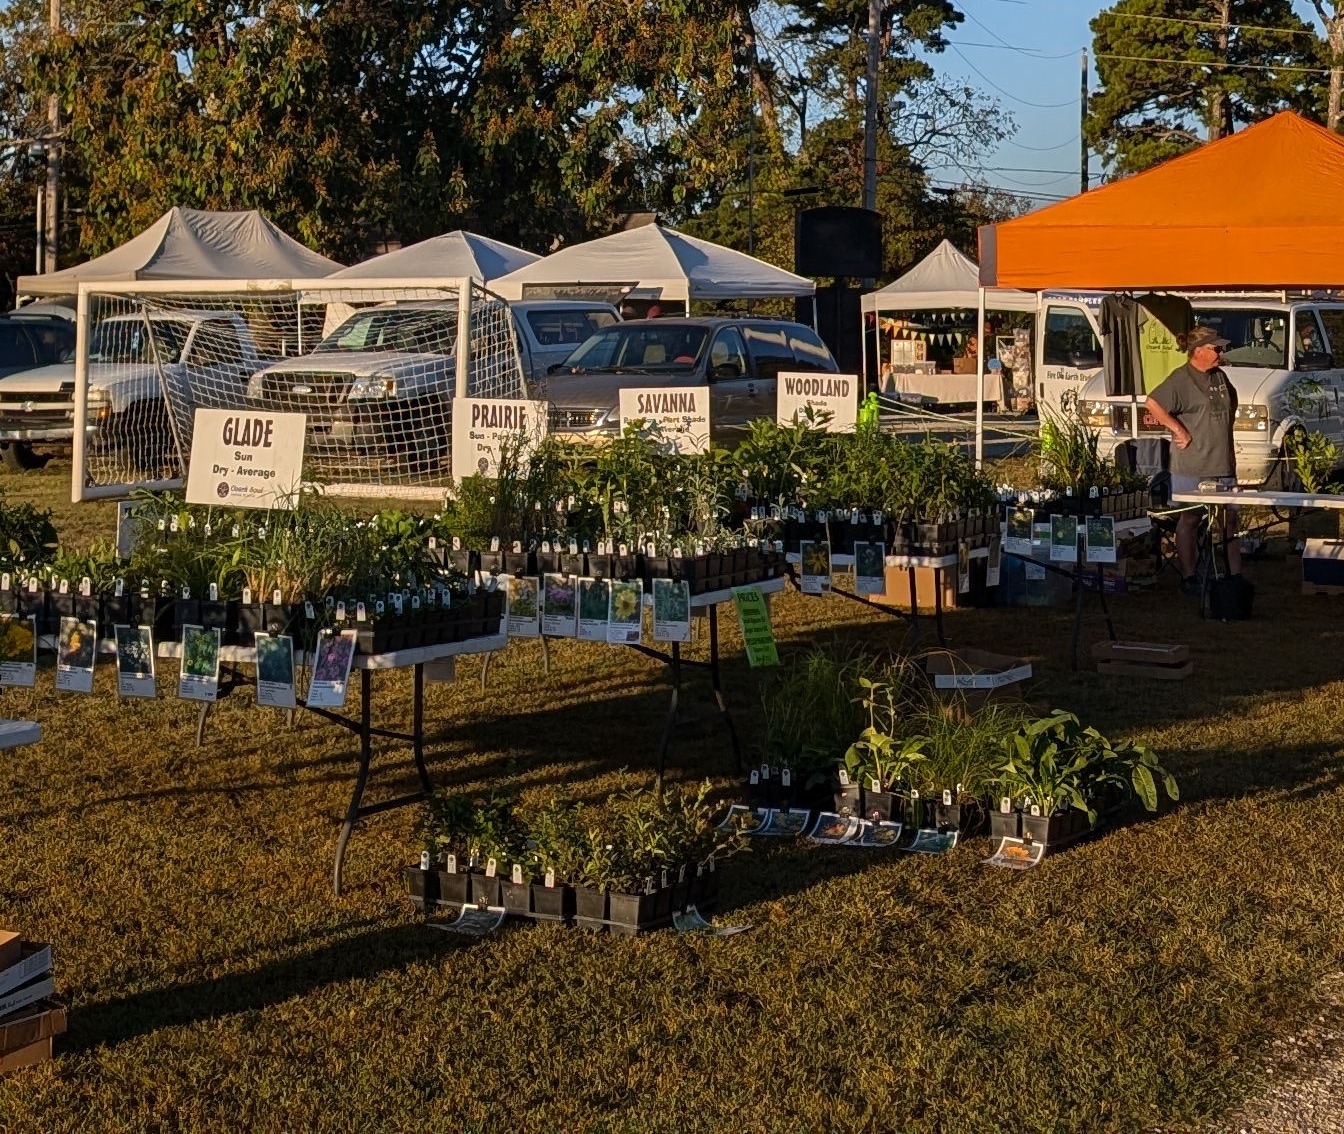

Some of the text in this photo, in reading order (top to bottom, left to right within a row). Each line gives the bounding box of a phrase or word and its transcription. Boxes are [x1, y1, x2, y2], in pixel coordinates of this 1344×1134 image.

[784, 377, 850, 397] WOODLAND
[637, 392, 696, 414] SAVANNA
[471, 403, 526, 430] PRAIRIE
[222, 417, 274, 448] GLADE
[234, 451, 253, 461] Sun
[212, 464, 229, 477] Dry
[236, 466, 276, 479] Average
